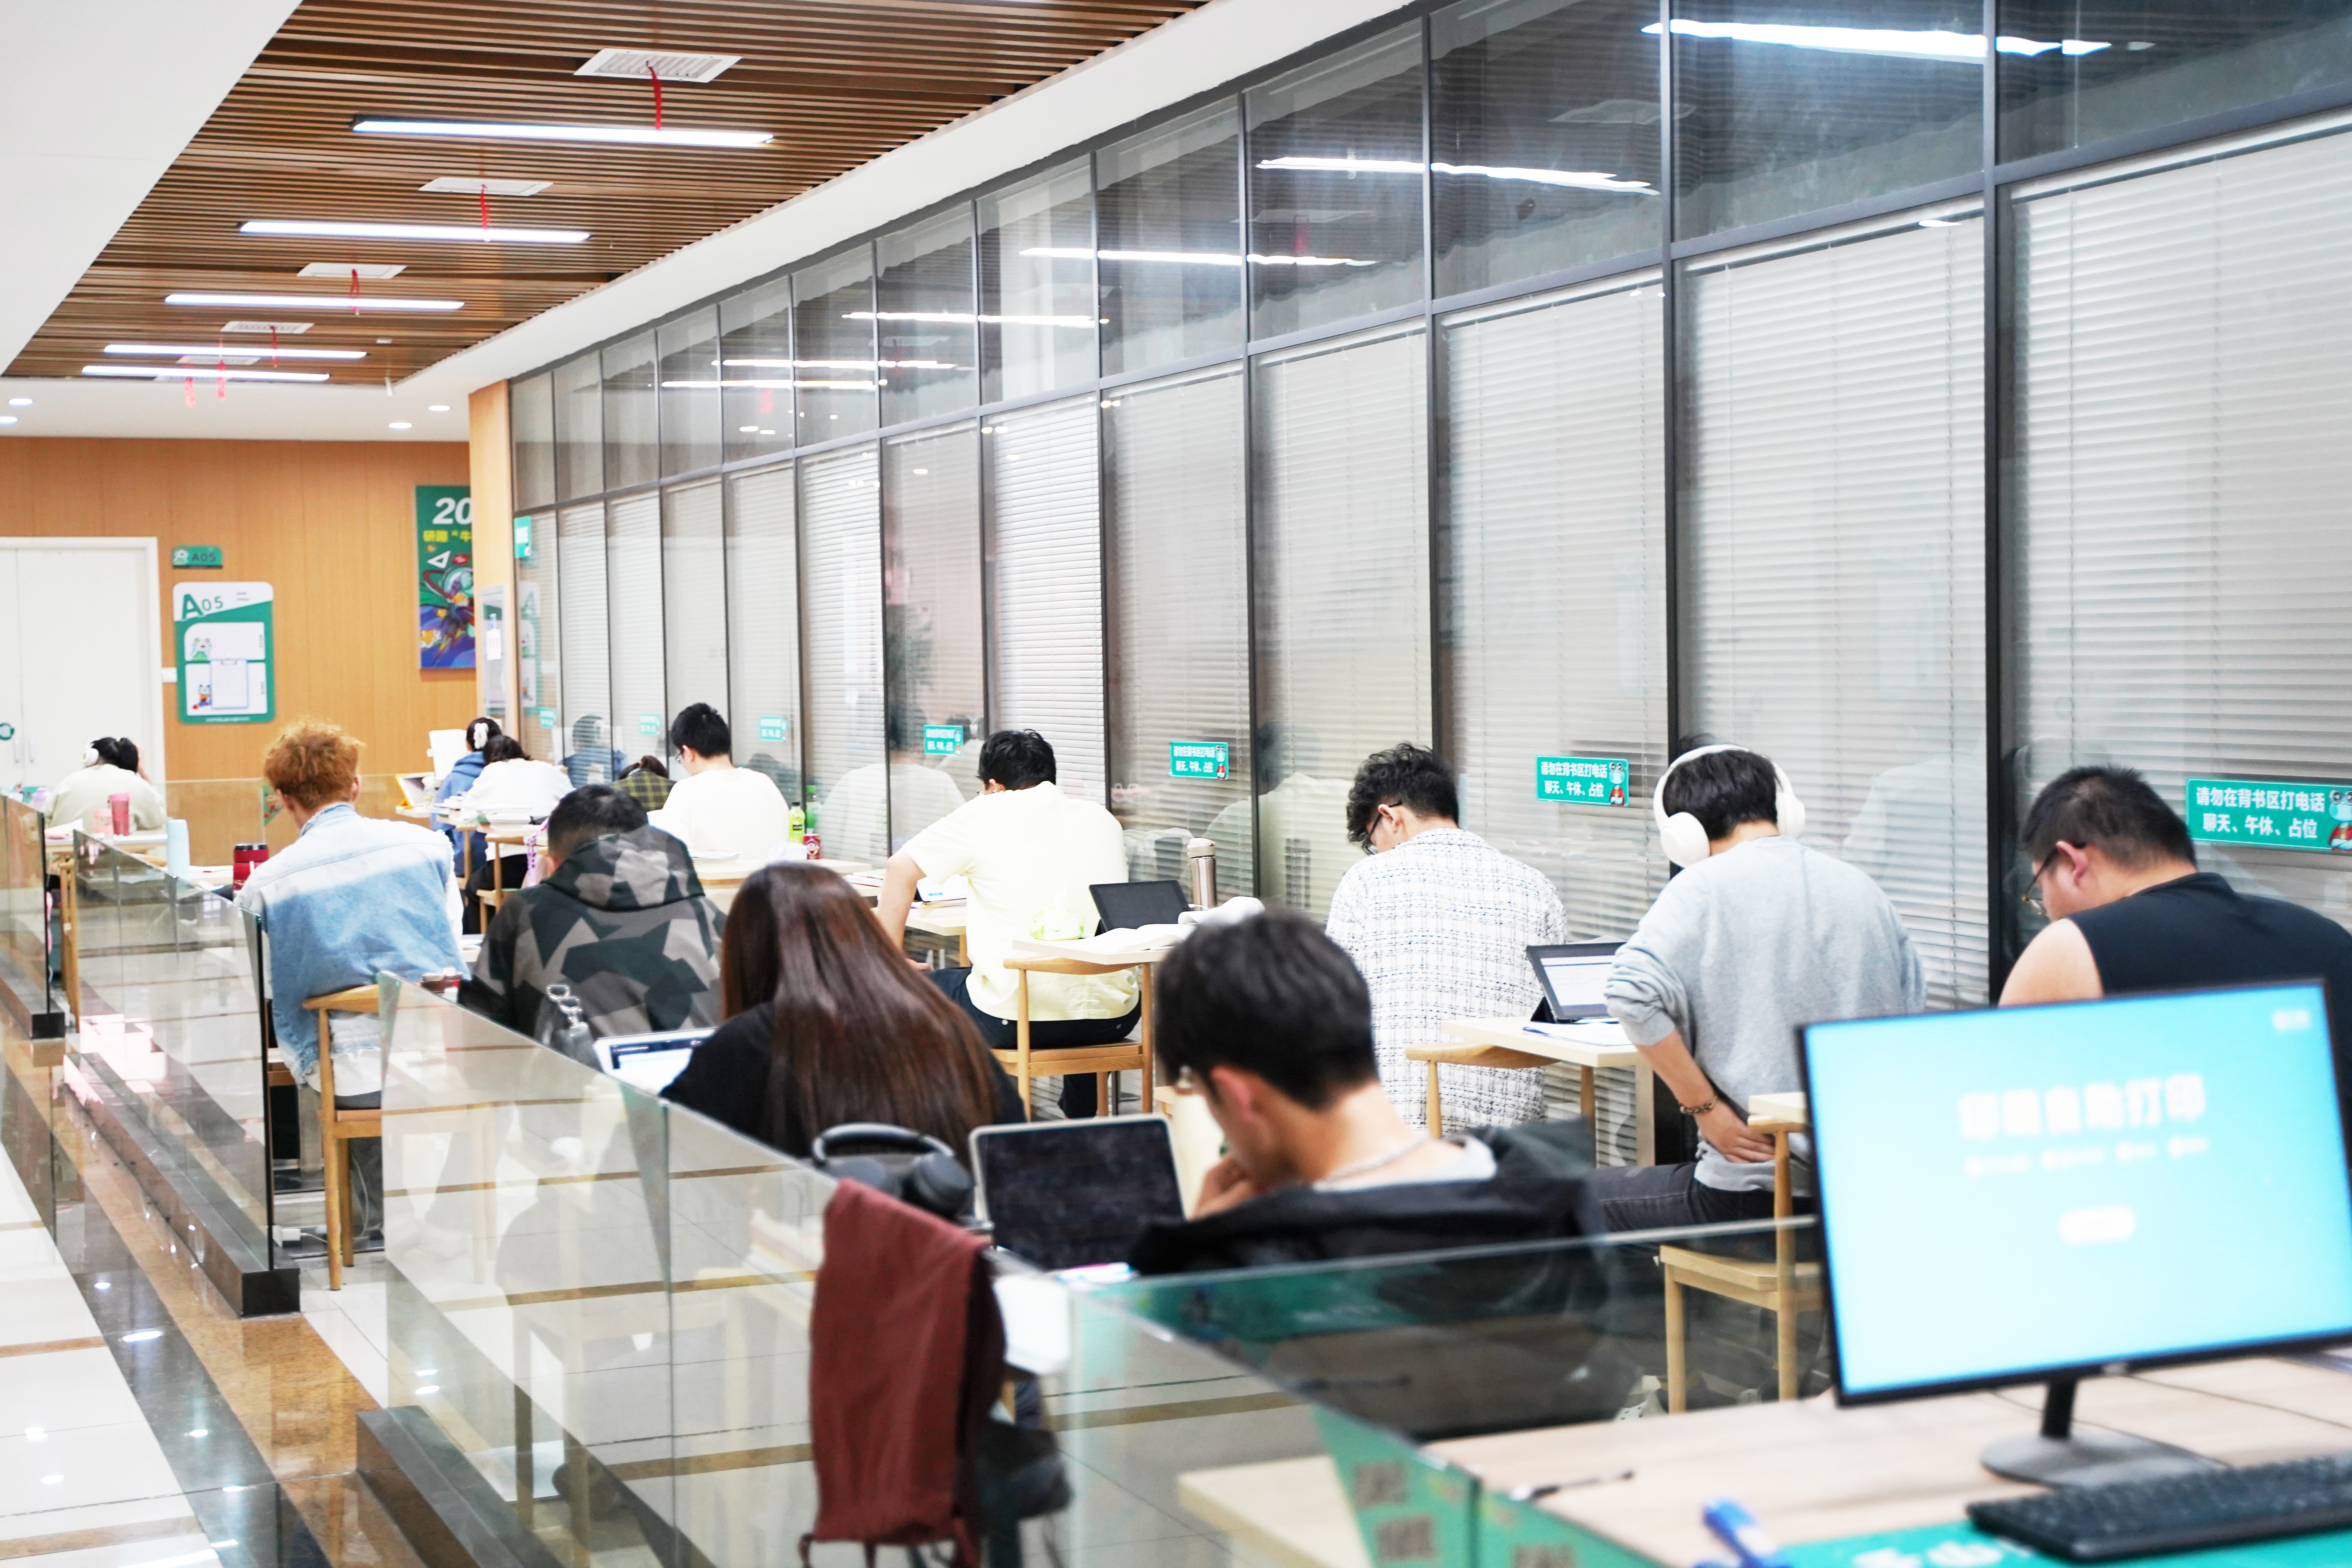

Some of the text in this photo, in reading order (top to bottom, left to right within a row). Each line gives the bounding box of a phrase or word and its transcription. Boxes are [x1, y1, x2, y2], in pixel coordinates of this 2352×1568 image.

[432, 497, 472, 525] 20
[190, 552, 216, 563] A05
[181, 593, 223, 621] A05
[2196, 786, 2325, 813] 请勿在背书区打电话
[2203, 813, 2318, 839] 聊天、午休、占位
